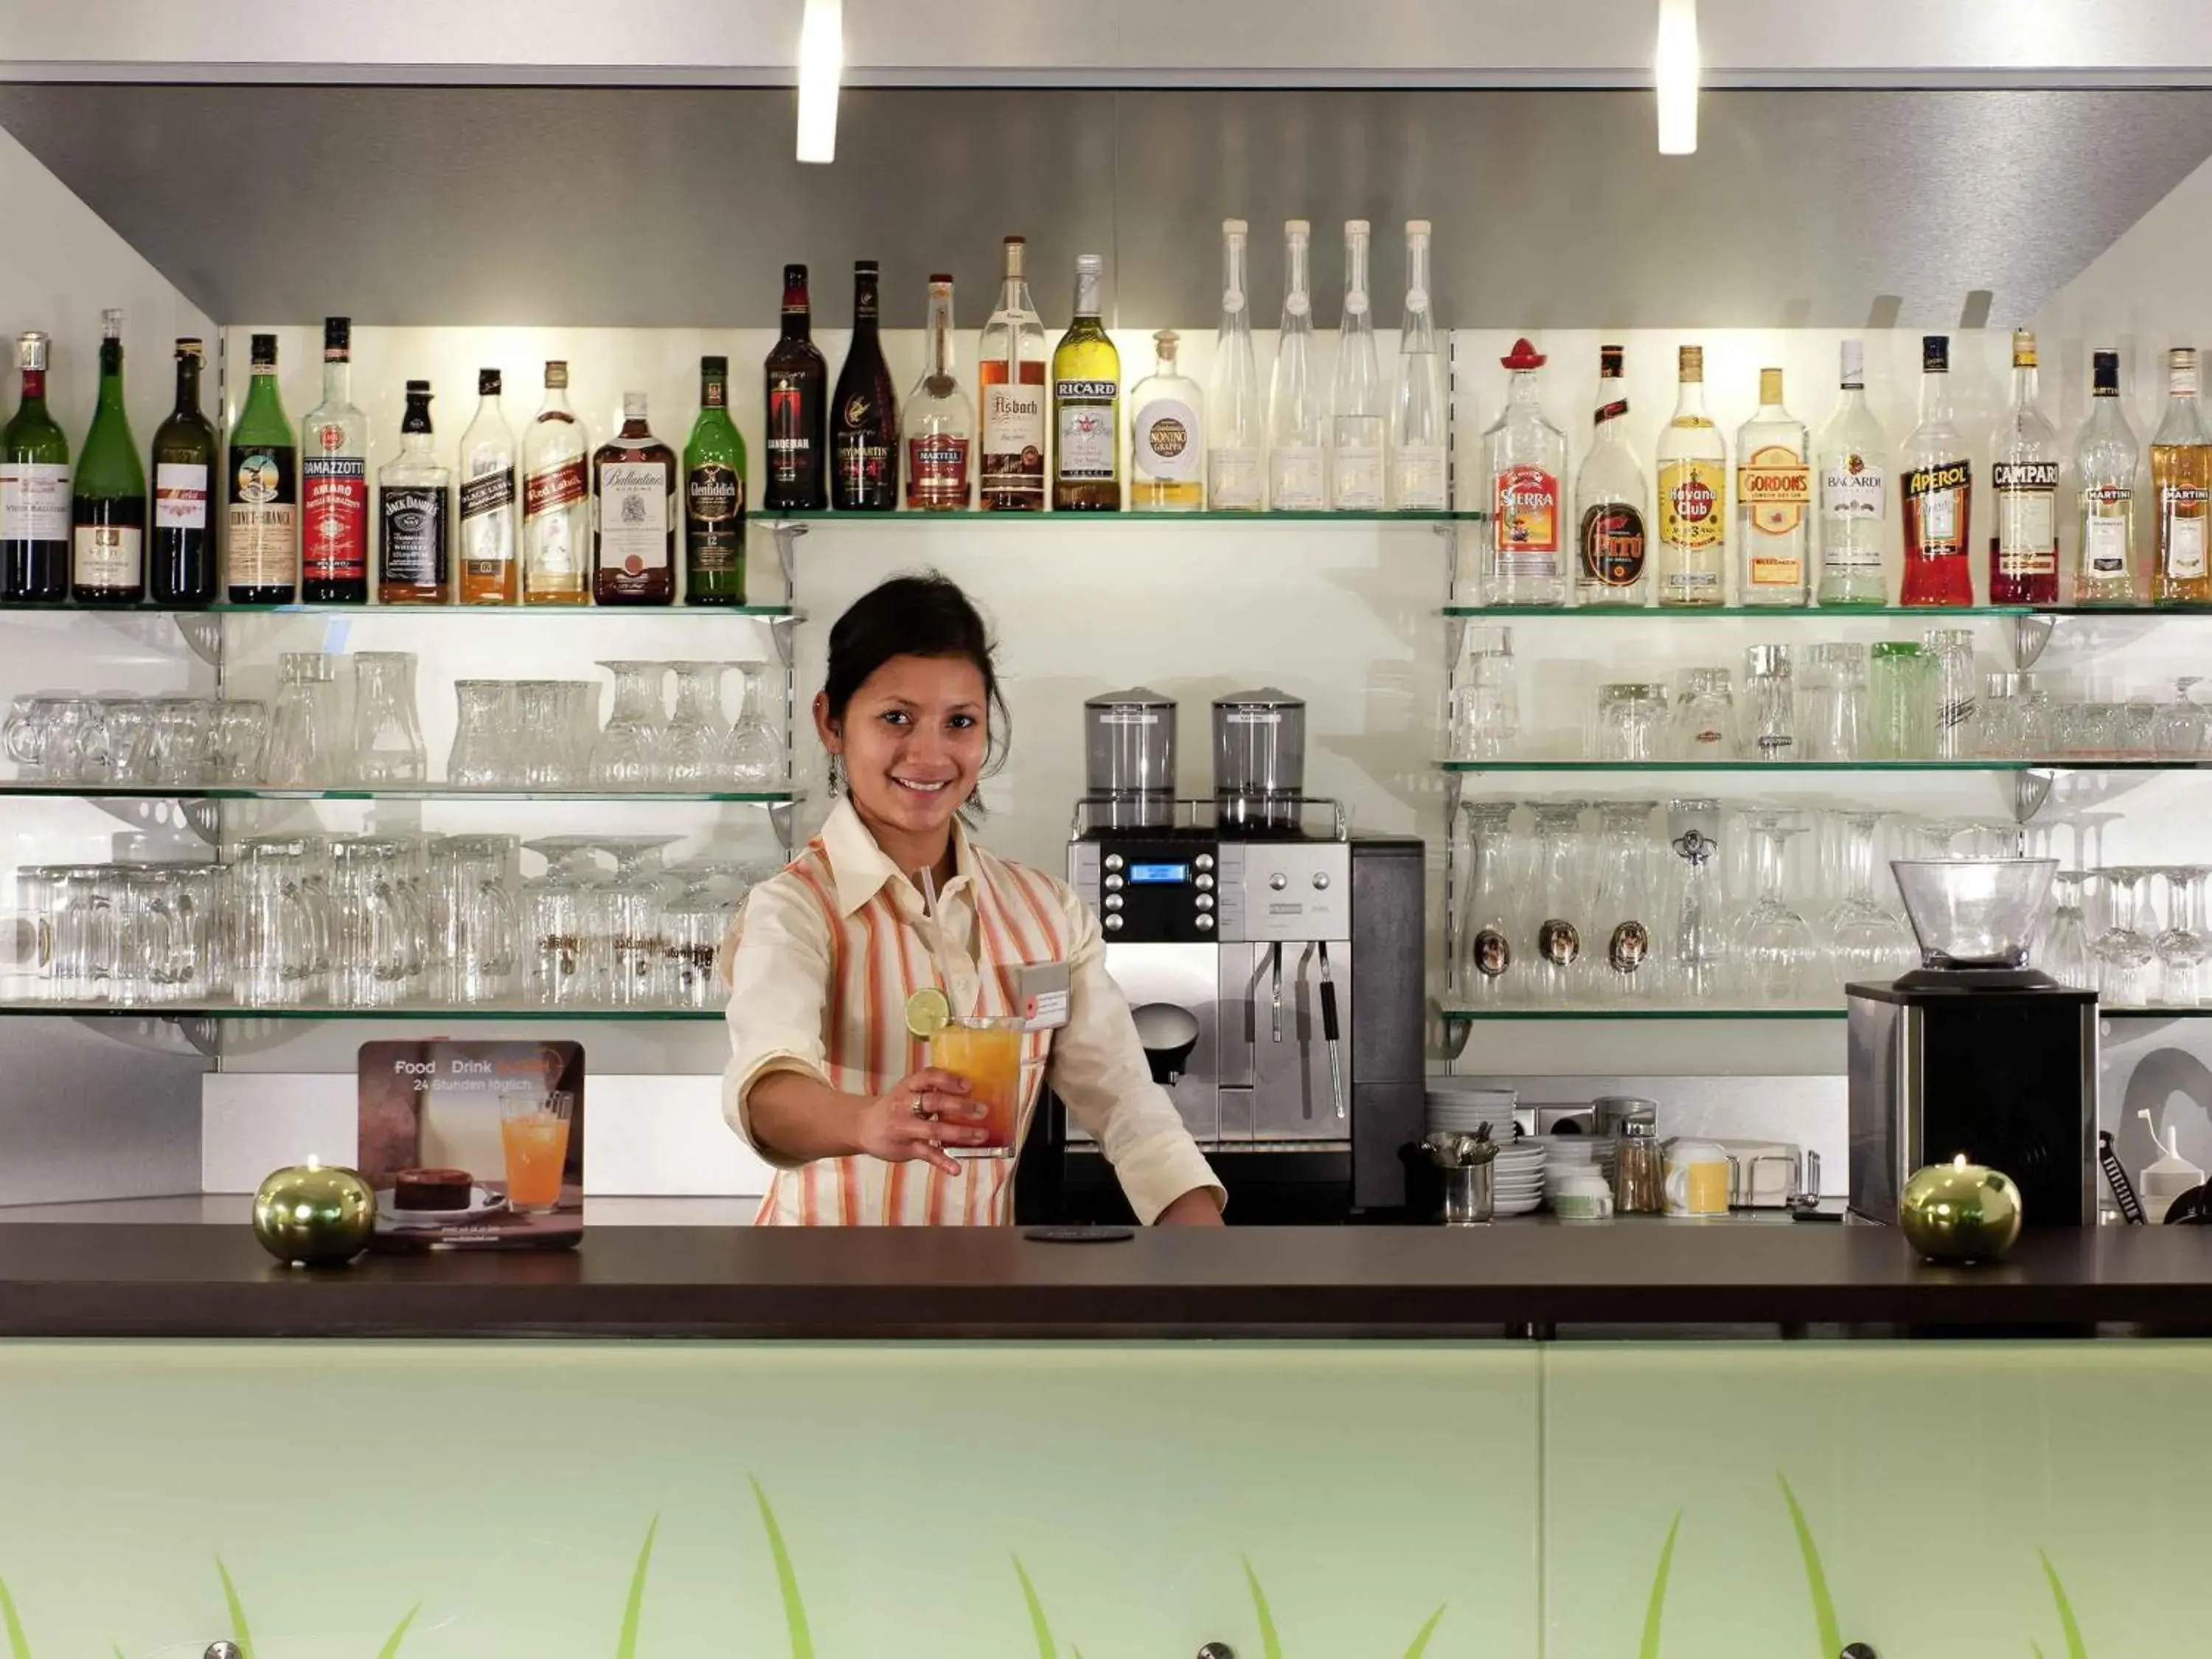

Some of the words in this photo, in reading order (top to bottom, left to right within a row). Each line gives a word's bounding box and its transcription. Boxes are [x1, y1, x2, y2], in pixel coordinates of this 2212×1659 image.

[1058, 383, 1115, 395] RICARD
[994, 395, 1038, 415] Asbach
[1151, 431, 1187, 442] NONINO
[1910, 467, 1966, 494] APEROL
[1994, 465, 2058, 484] CAMPARI
[1828, 476, 1881, 487] BACARDI
[1500, 488, 1554, 507] SIERRA
[1669, 487, 1717, 501] Havana
[2088, 490, 2130, 499] MARTINI
[2167, 490, 2208, 499] MARTINI
[1677, 501, 1708, 516] Club
[708, 535, 718, 546] 12
[395, 1060, 437, 1074] Food
[451, 1060, 493, 1074] Drink
[414, 1079, 428, 1091] 24
[434, 1079, 487, 1091] Stunden
